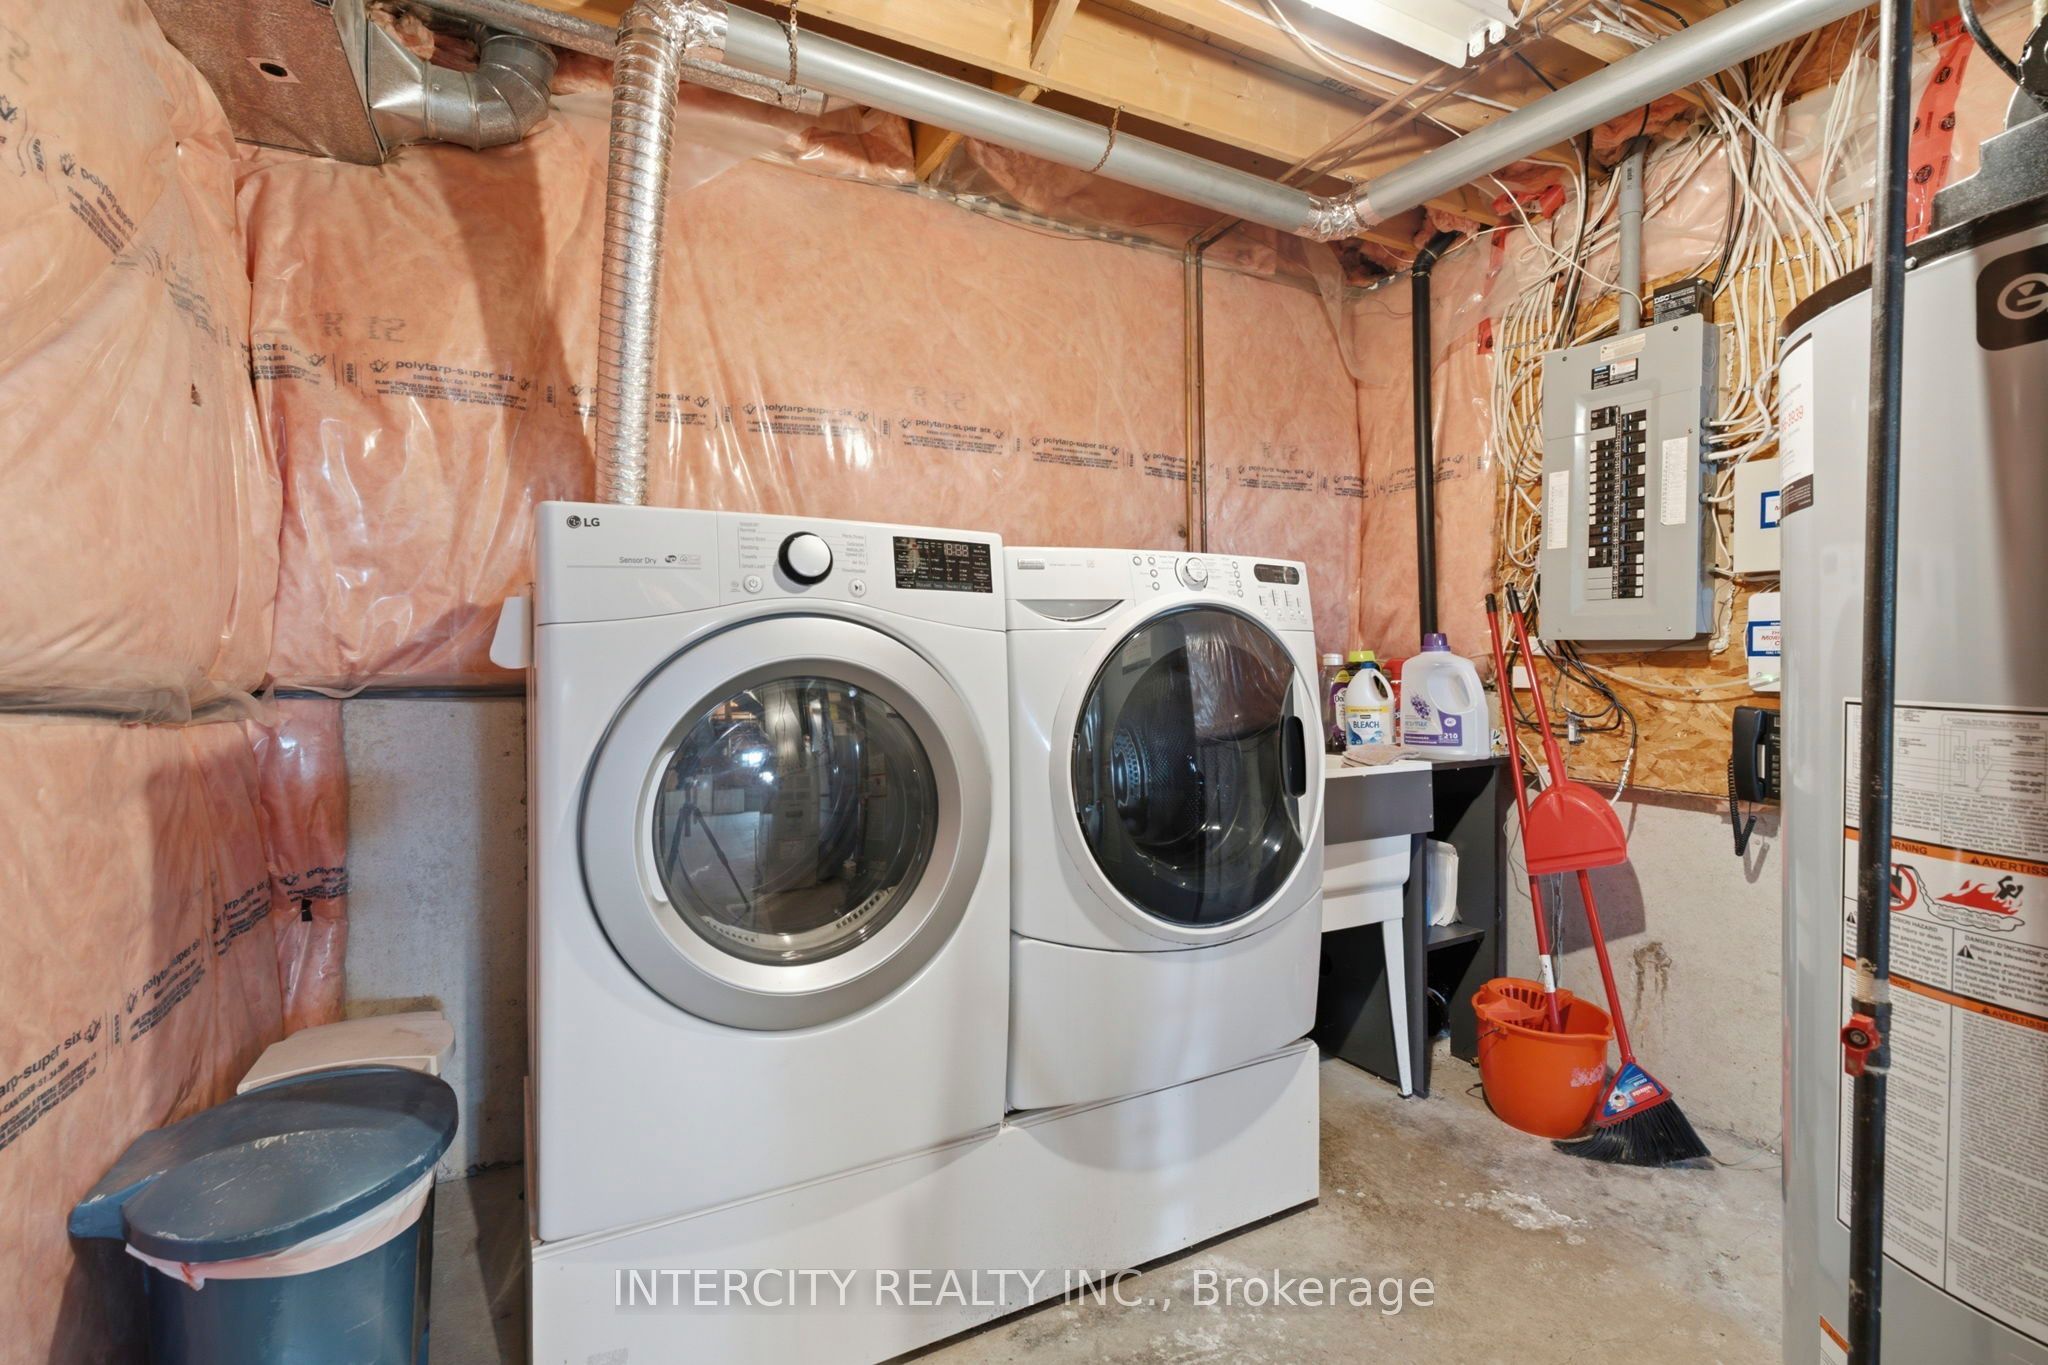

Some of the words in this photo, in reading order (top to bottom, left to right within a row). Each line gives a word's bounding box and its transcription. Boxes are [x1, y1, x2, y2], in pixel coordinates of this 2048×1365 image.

[395, 360, 495, 380] polytarp-super
[497, 374, 516, 383] six
[915, 418, 978, 434] polytarp-super
[1043, 437, 1097, 450] polytarp-super
[583, 518, 601, 527] LG
[619, 556, 644, 564] Sensor
[644, 557, 657, 566] Dry
[1353, 720, 1380, 729] BLEACH
[1982, 858, 2048, 877] AVERTISS
[1964, 934, 1996, 948] DANGER
[64, 1029, 83, 1051] six
